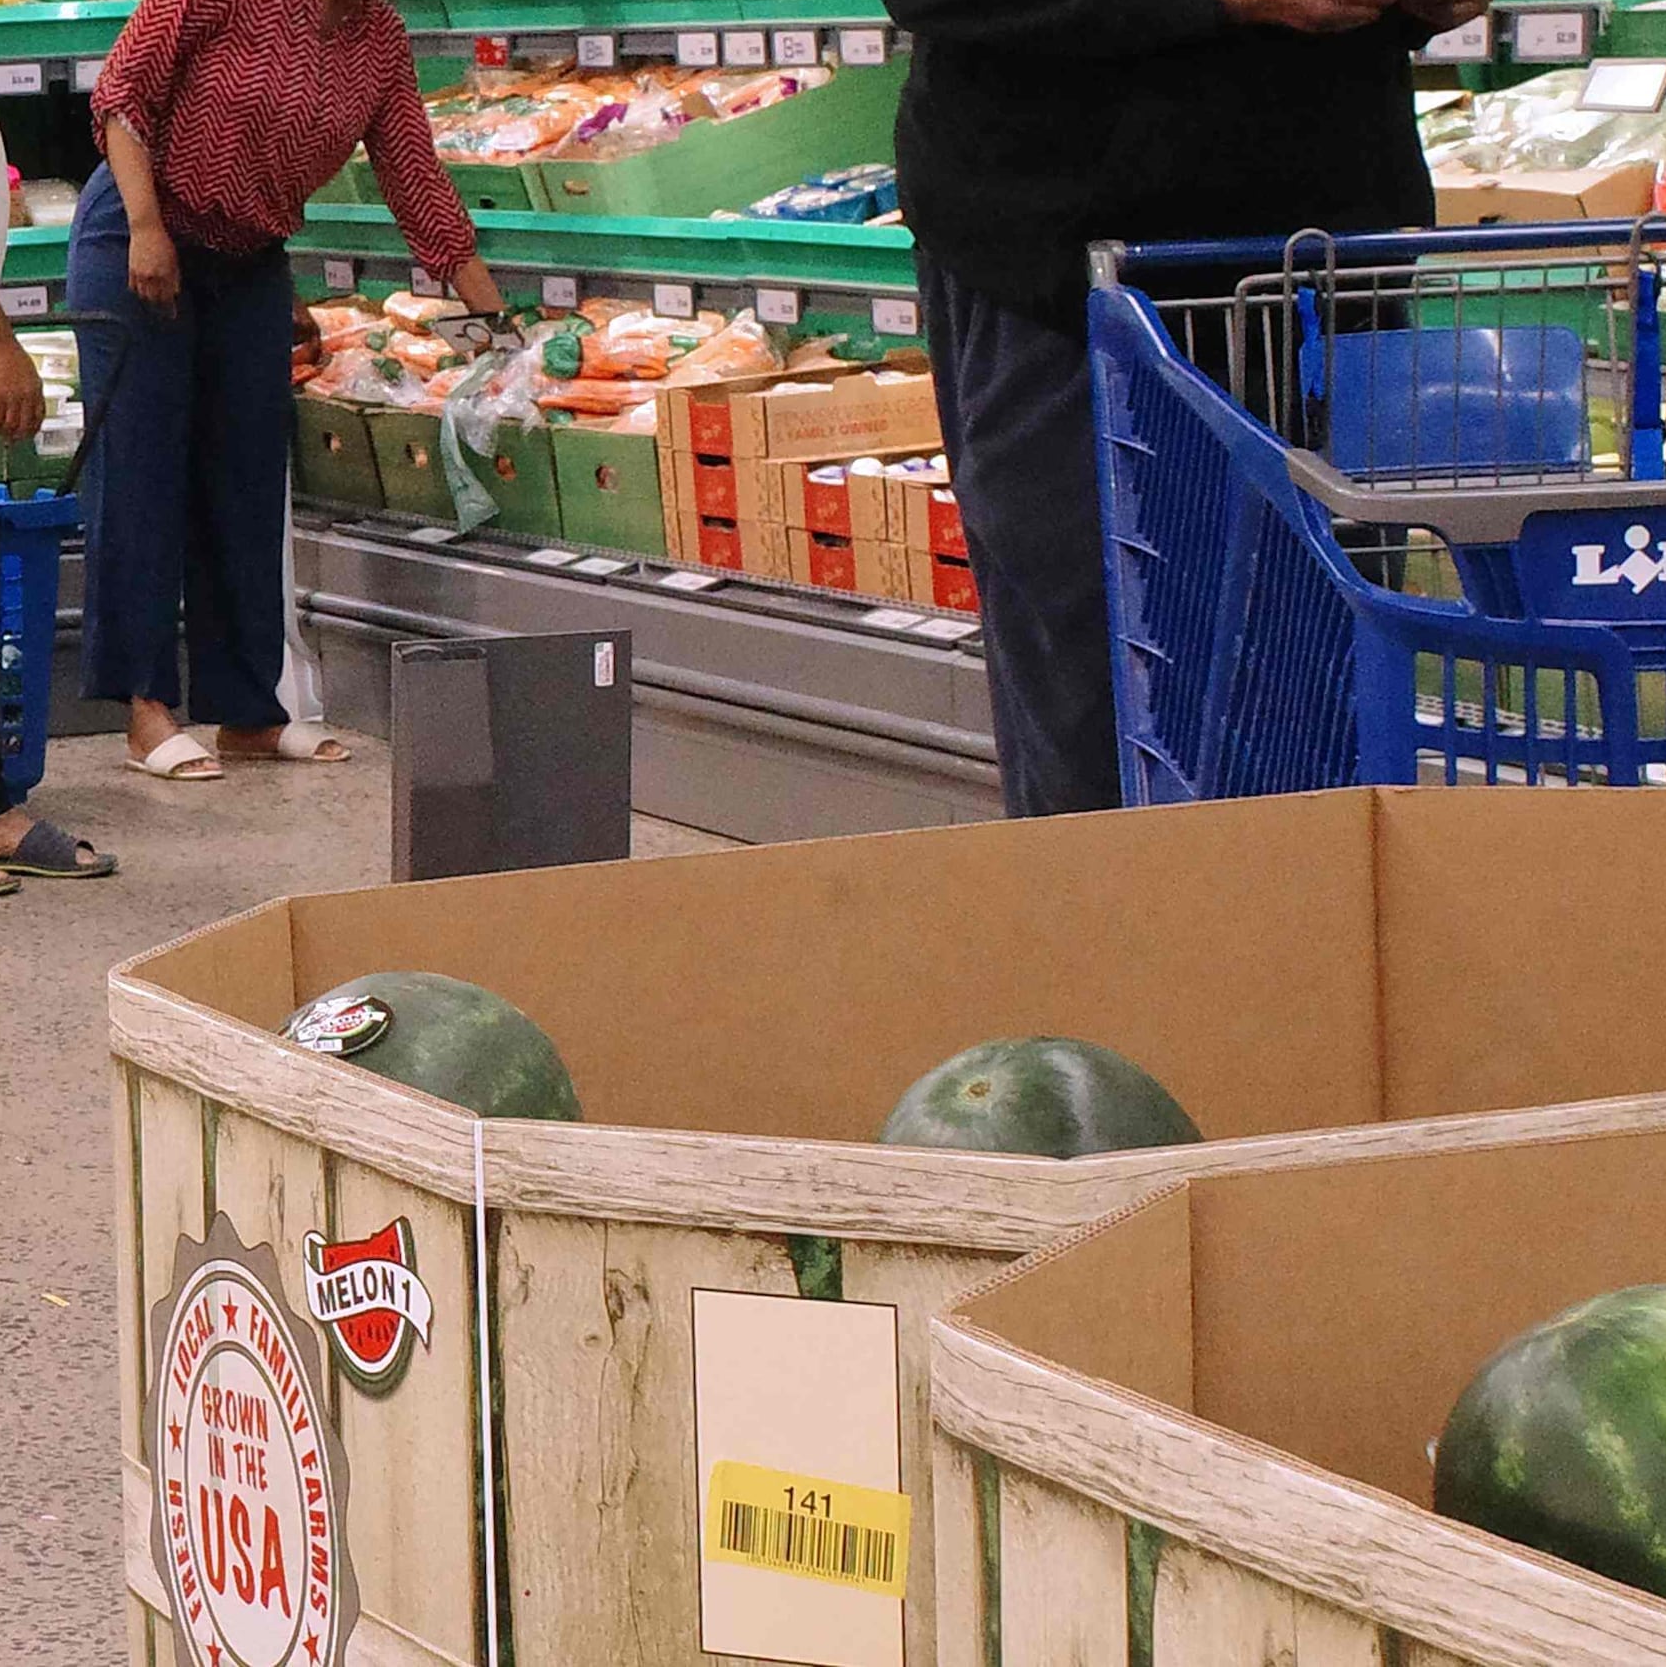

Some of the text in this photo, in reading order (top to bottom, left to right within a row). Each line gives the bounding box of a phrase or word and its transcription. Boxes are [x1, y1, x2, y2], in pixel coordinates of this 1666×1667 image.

[316, 1265, 411, 1315] MELON 1
[172, 1296, 216, 1397] LOCAL
[201, 1383, 270, 1442] GROWN
[207, 1432, 269, 1492] IN THE
[248, 1302, 330, 1620] FAMILY FARMS
[783, 1486, 832, 1518] 141
[167, 1478, 202, 1625] FRESH
[199, 1483, 292, 1620] USA
